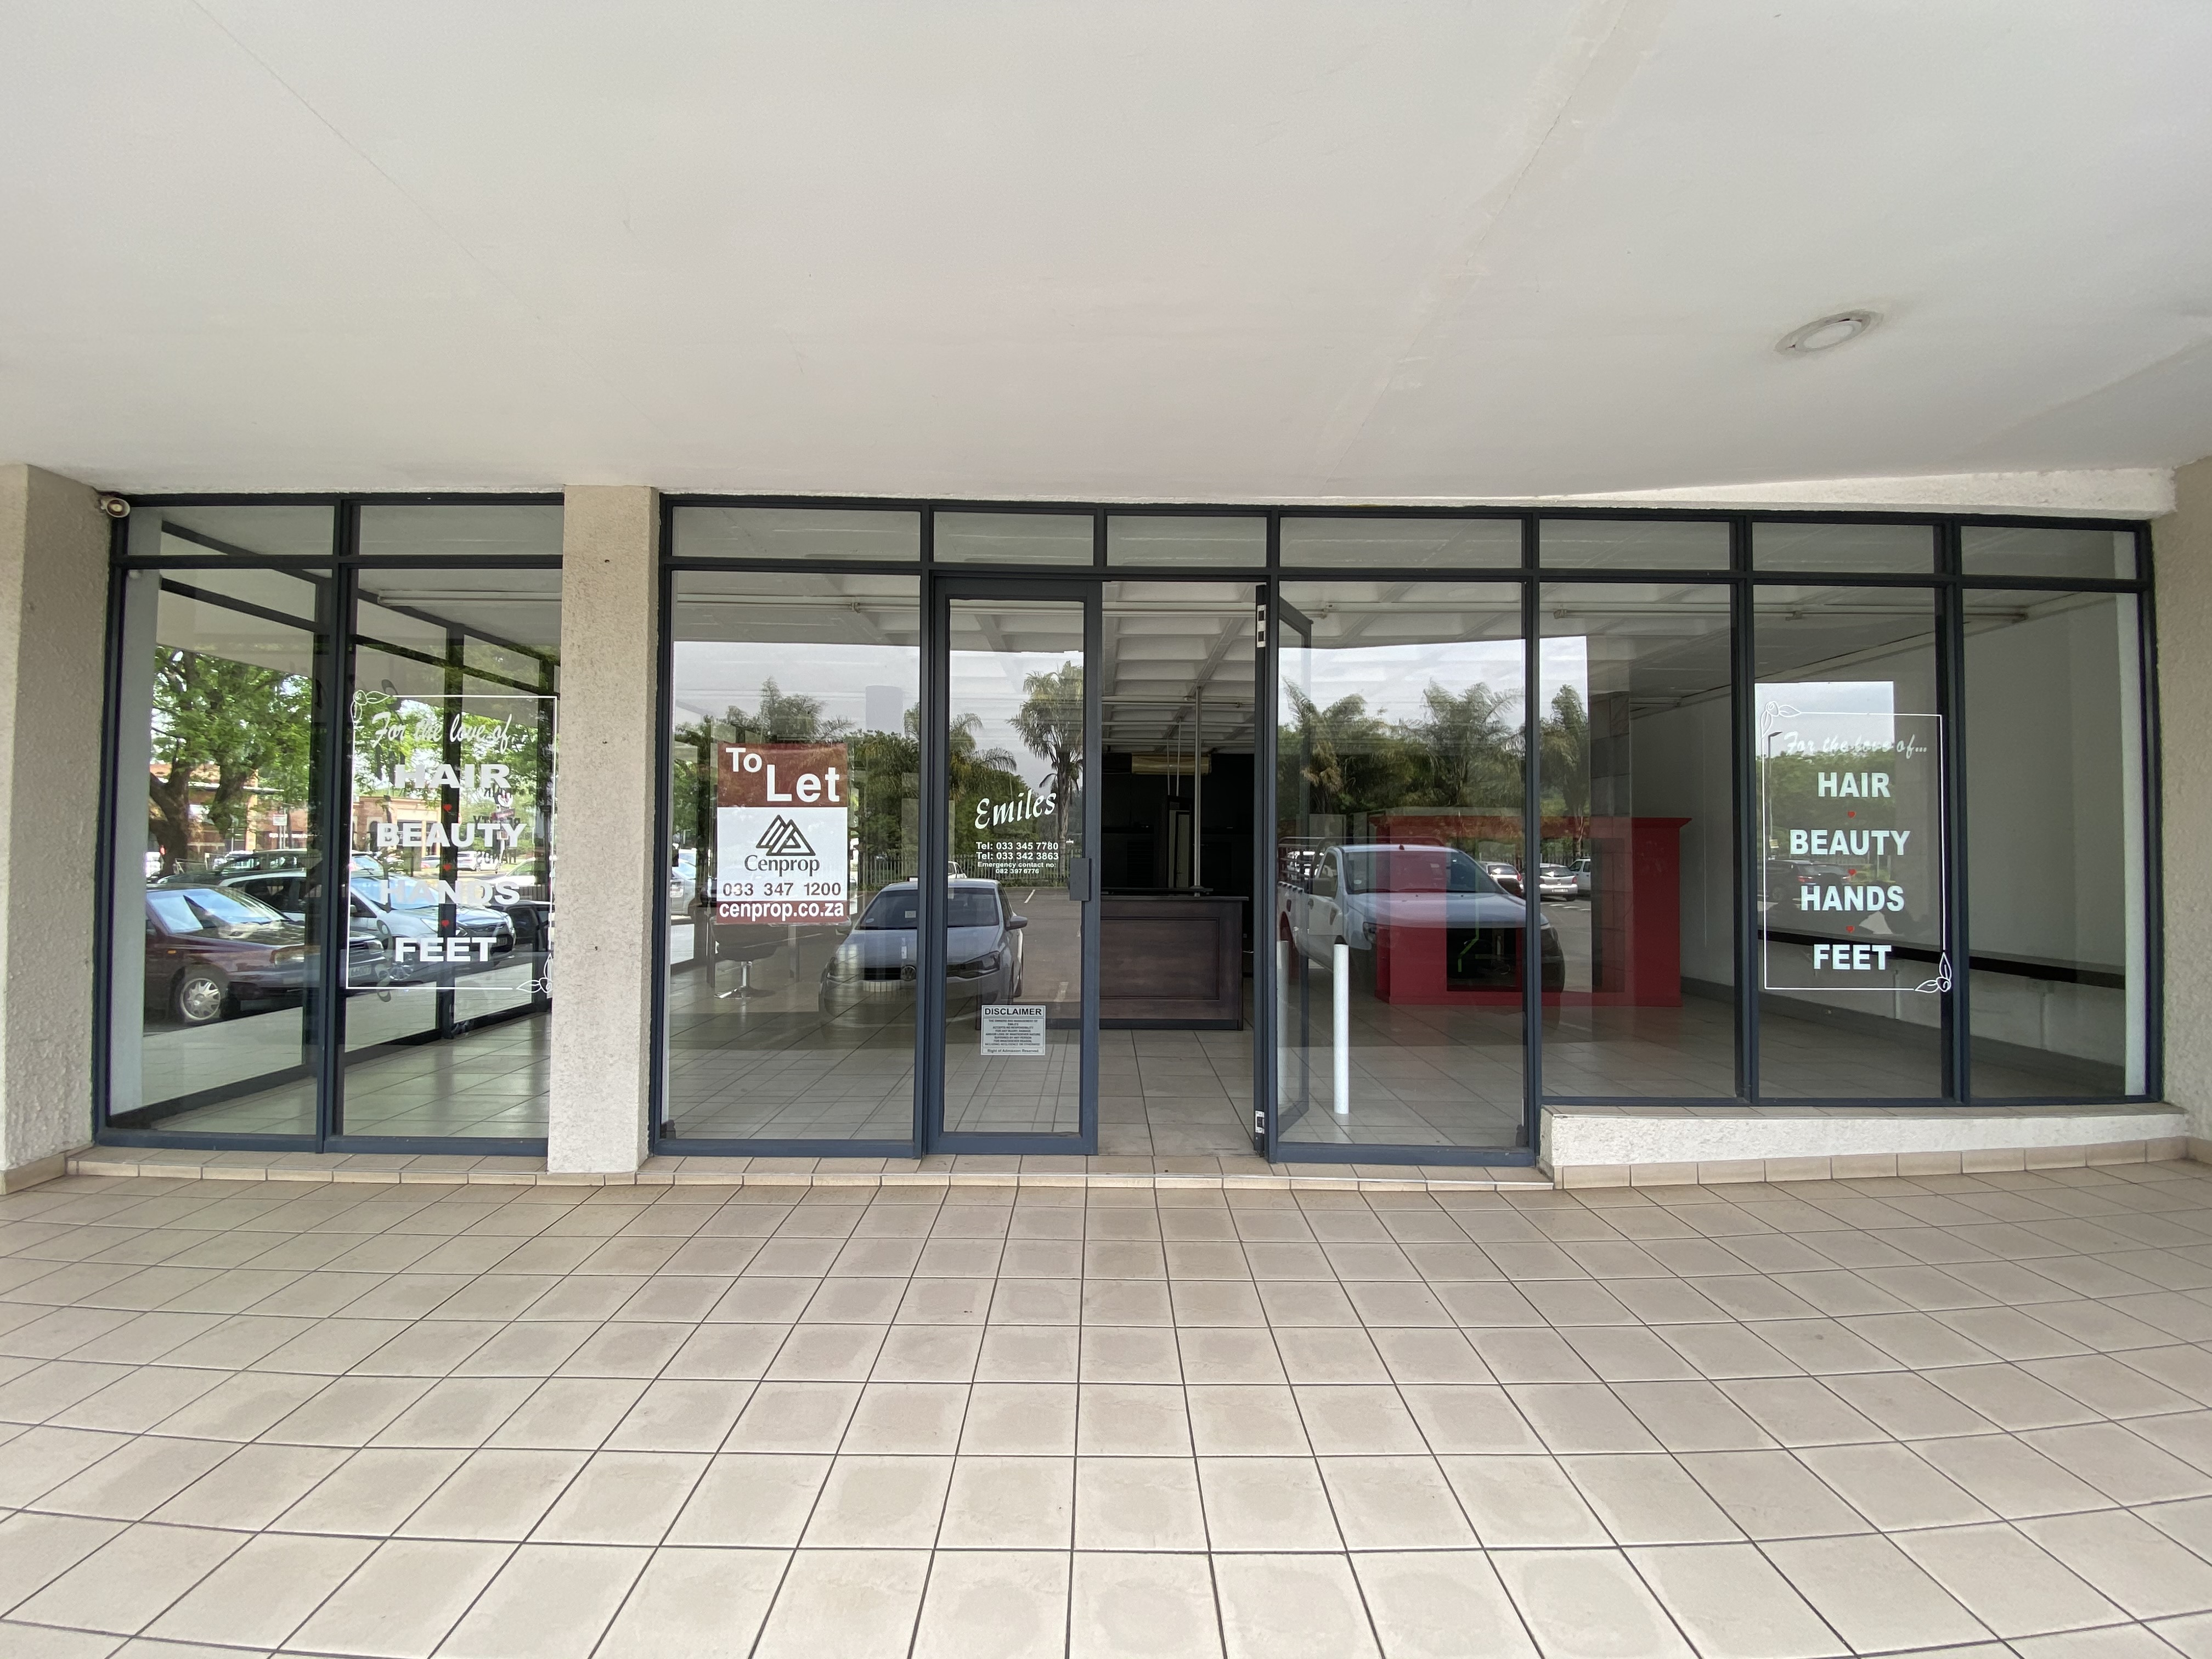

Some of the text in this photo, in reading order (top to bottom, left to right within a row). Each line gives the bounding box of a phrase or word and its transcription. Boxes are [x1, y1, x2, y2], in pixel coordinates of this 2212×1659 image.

[372, 712, 407, 748] For
[415, 718, 443, 742] the
[450, 713, 486, 742] love
[1784, 731, 1815, 756] For
[1822, 734, 1849, 753] the
[1854, 735, 1892, 753] love
[394, 764, 511, 789] HAIR
[726, 748, 840, 803] To Let
[1818, 772, 1891, 798] HAIR
[975, 789, 1057, 829] Emiles
[377, 823, 527, 848] BEAUTY
[976, 842, 993, 850] Tel:
[1790, 830, 1910, 855] BEAUTY
[744, 855, 820, 877] Cenprop
[380, 880, 520, 905] HANDS
[723, 882, 841, 896] 033 347 1200
[1801, 885, 1904, 912] HANDS
[719, 902, 844, 922] cenprop.co.za
[395, 936, 497, 962] FEET
[1813, 944, 1892, 970] FEET
